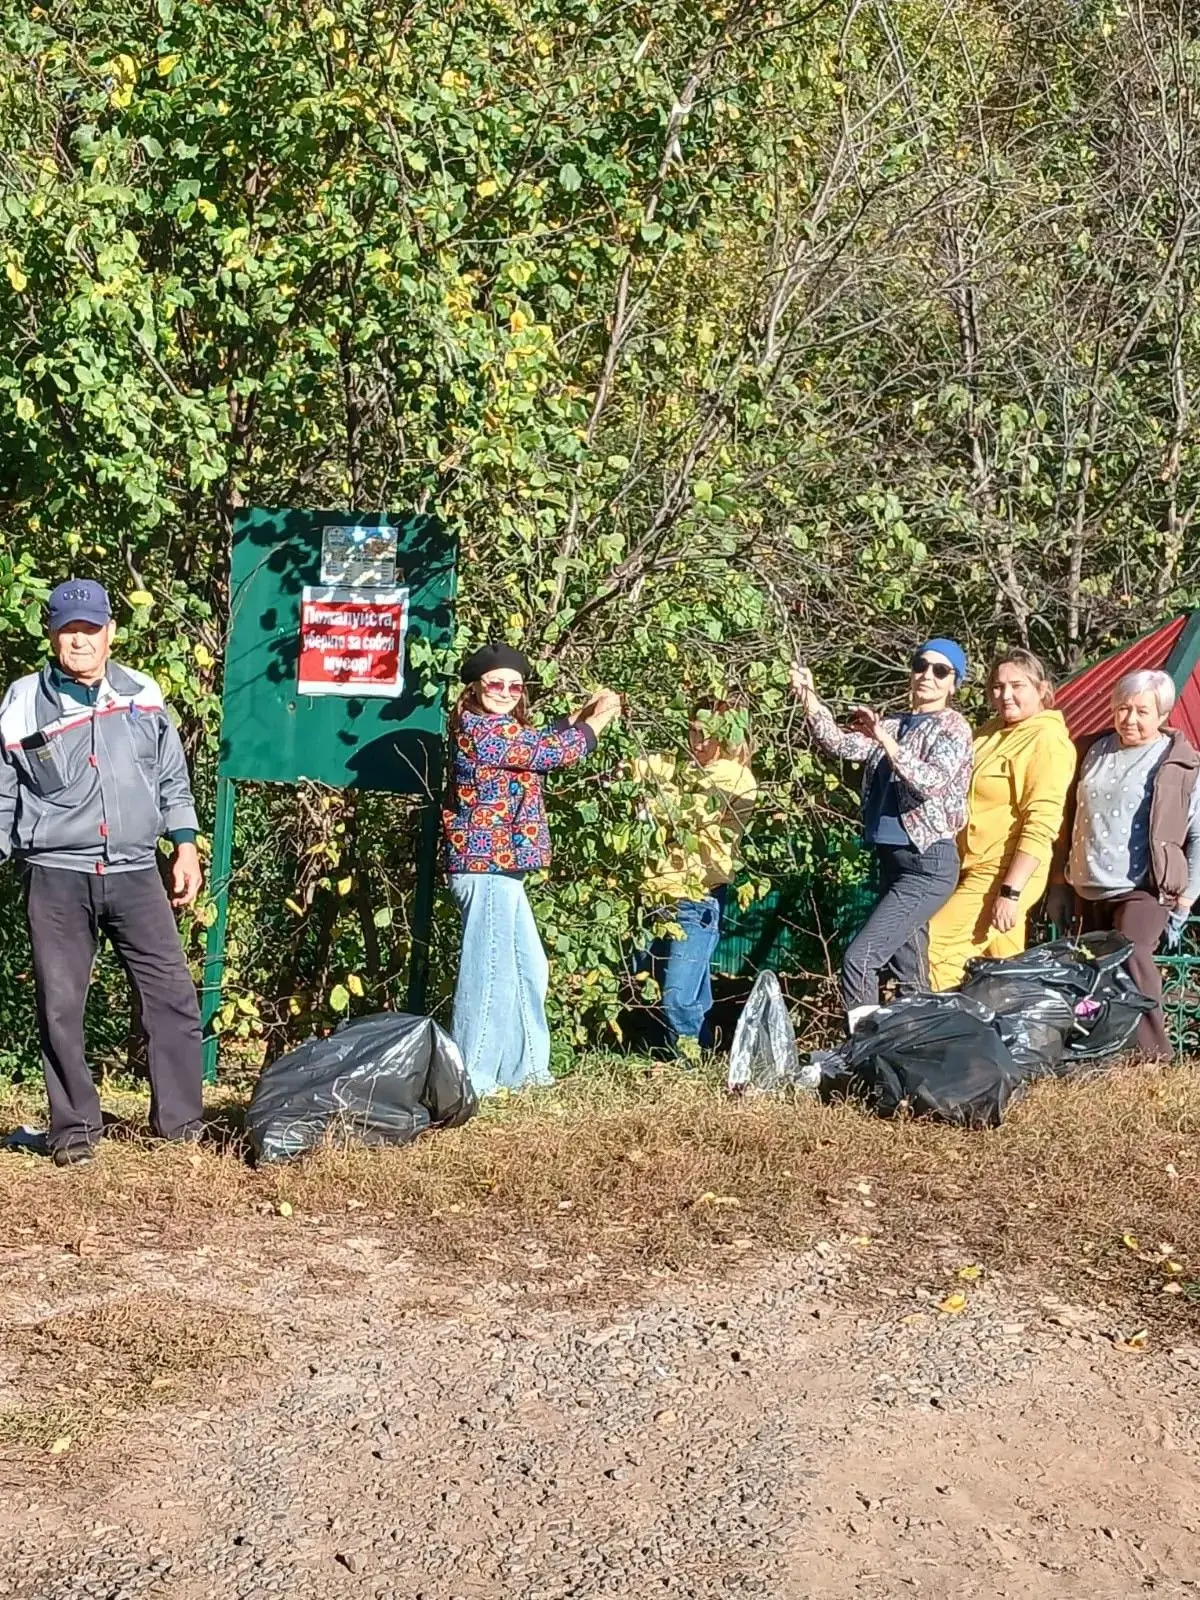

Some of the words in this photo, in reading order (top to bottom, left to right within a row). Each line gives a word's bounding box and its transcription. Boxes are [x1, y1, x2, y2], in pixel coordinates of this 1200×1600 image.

[303, 605, 396, 630] Пожалуйста,
[303, 630, 345, 652] уберите
[347, 635, 361, 650] за
[362, 632, 395, 650] собой
[323, 653, 372, 675] мусор!
